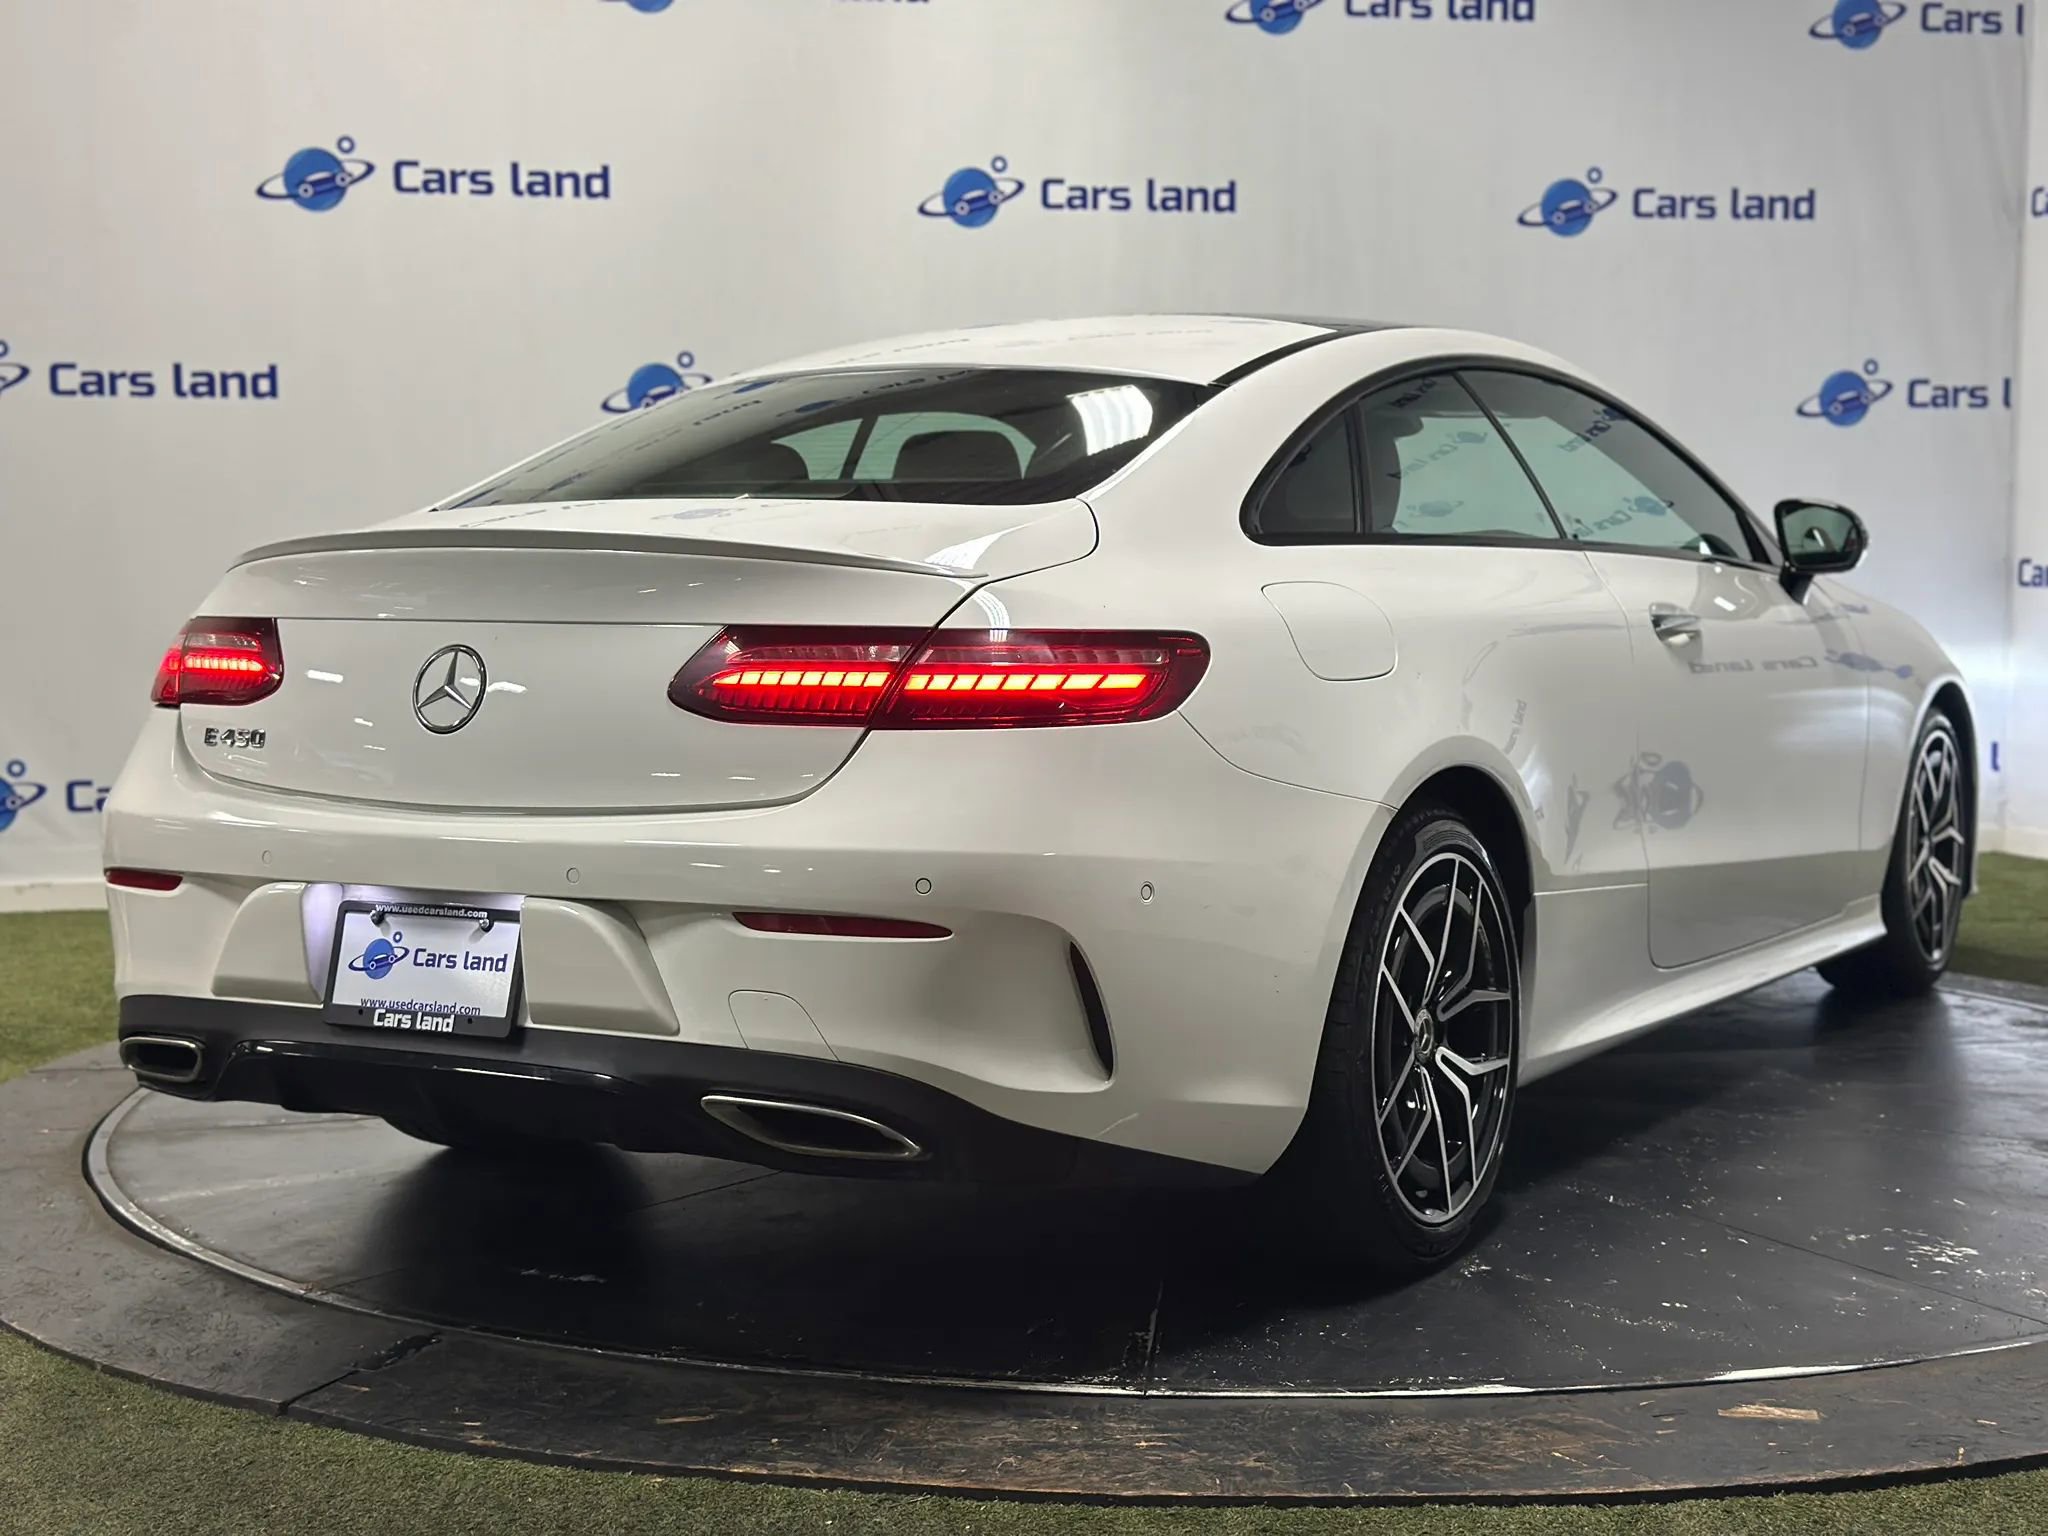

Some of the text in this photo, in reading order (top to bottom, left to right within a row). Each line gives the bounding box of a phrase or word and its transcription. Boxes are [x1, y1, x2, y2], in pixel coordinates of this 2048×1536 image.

[1447, 0, 1535, 21] land
[1921, 2, 2003, 34] Cars
[393, 160, 610, 198] Cars land
[1041, 178, 1236, 213] Cars land
[1632, 188, 1816, 221] Cars land
[49, 363, 278, 399] Cars land
[1907, 378, 1989, 408] Cars
[375, 904, 488, 919] www.usedcarsland.com
[412, 948, 509, 973] Cars land
[360, 998, 481, 1016] www.usedcarsland.com
[373, 1008, 455, 1033] Cars land
